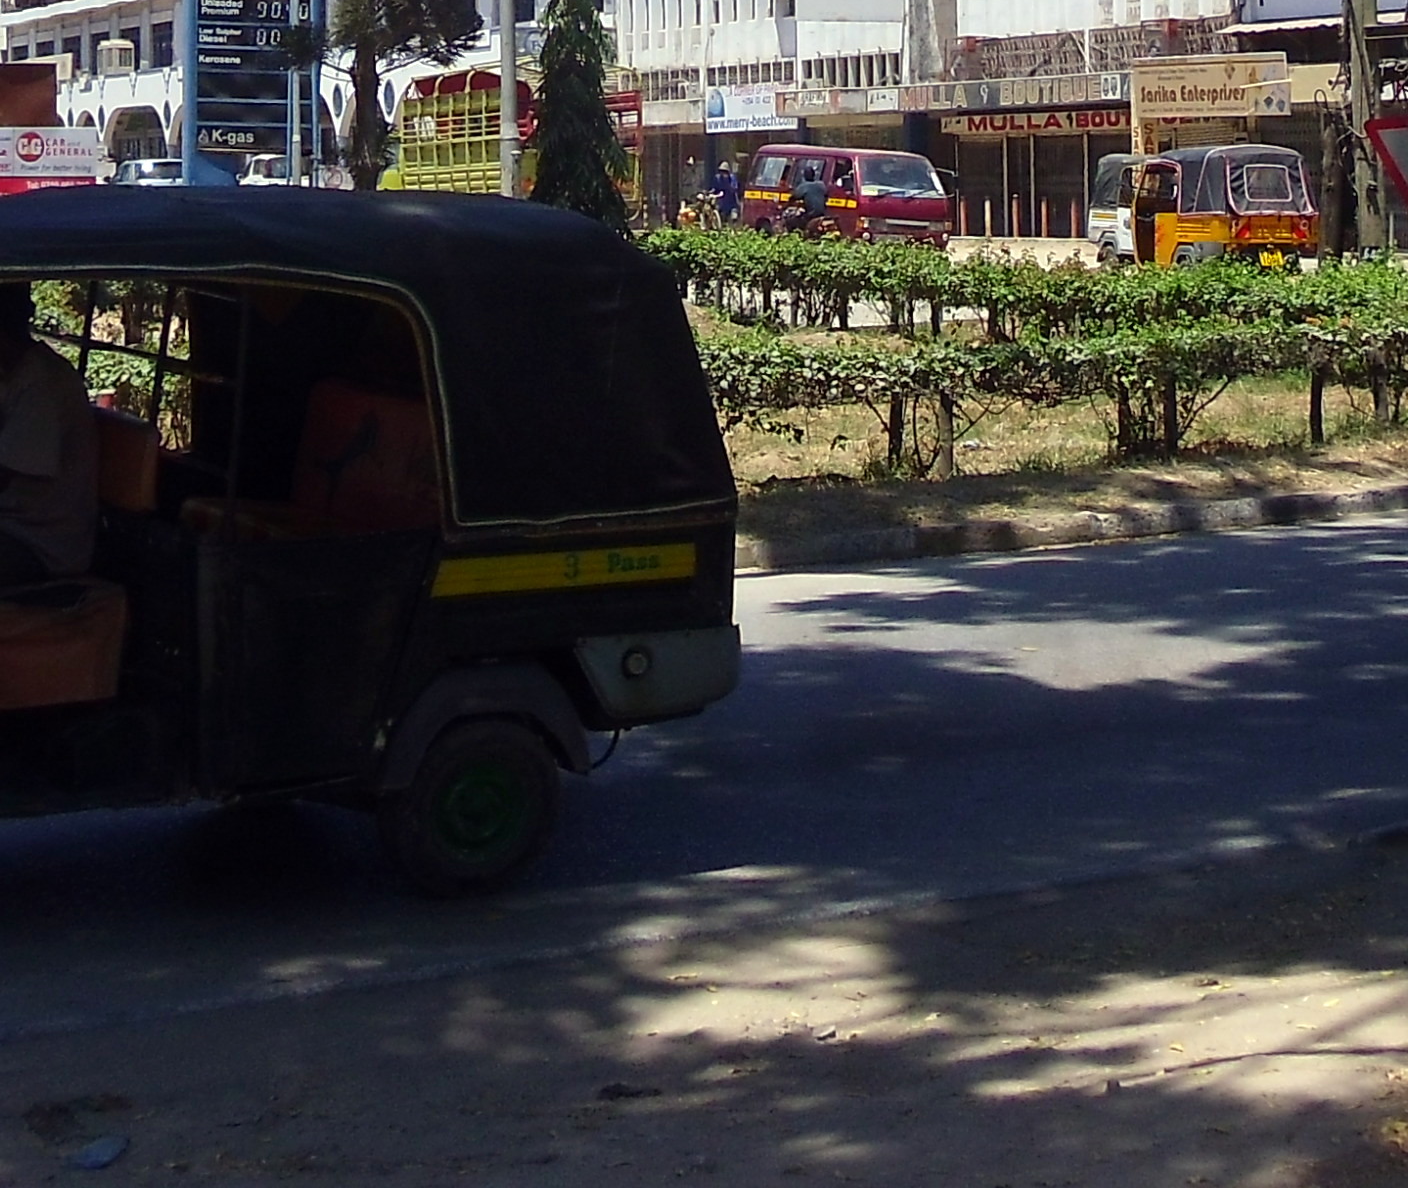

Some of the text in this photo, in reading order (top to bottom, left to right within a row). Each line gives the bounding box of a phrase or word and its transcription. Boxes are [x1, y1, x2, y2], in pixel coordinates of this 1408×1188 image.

[199, 55, 241, 64] Kerosene
[900, 75, 1100, 111] MULLA BOUTIQUE
[1141, 83, 1246, 105] Sarika Enterprises
[967, 113, 1062, 132] MULLA
[212, 129, 255, 145] K-gas
[45, 147, 93, 157] GENERAL
